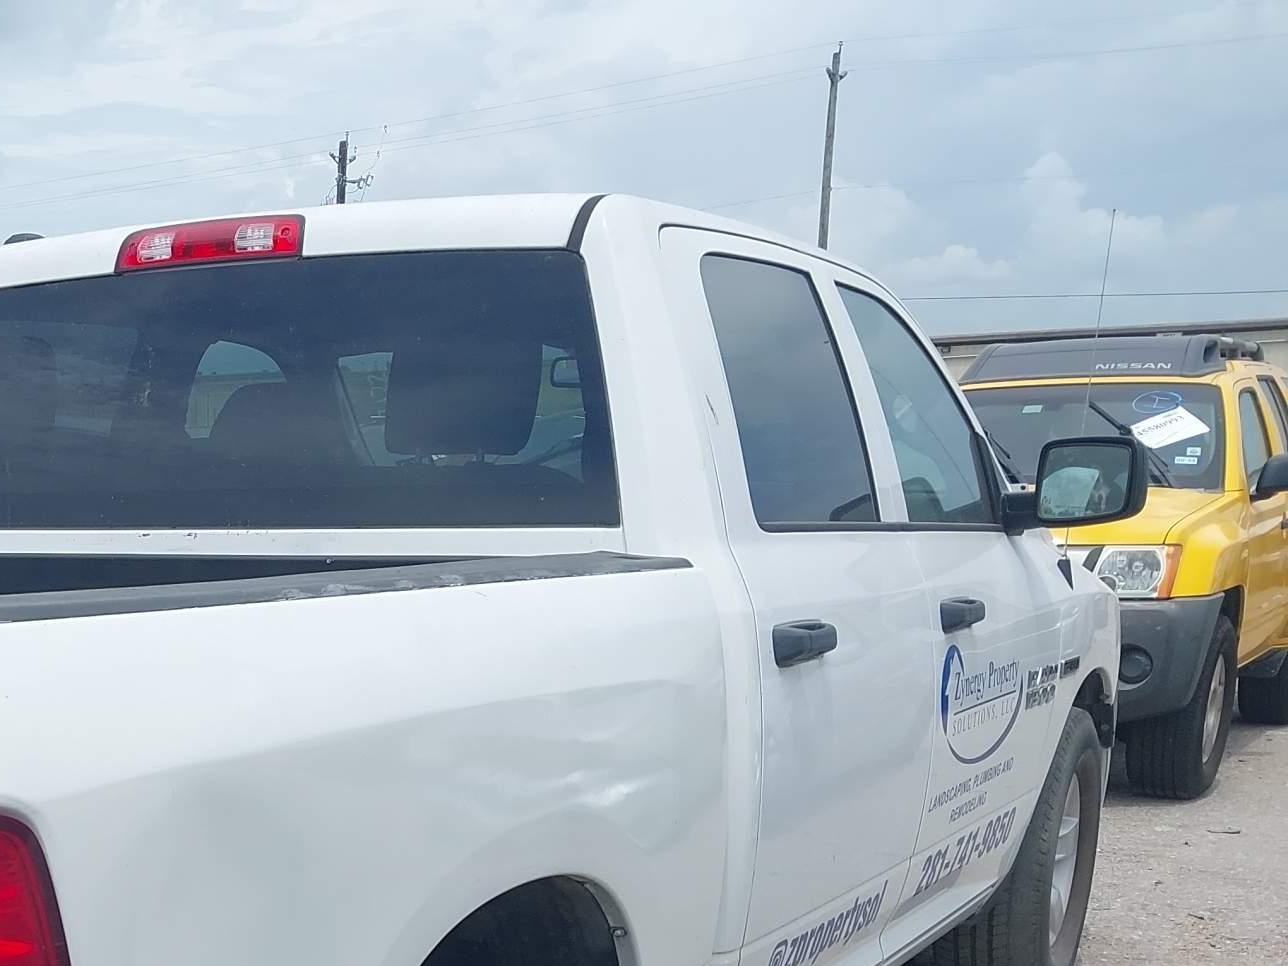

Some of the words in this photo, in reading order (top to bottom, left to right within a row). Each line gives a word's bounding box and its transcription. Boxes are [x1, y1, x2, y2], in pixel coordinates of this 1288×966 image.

[1095, 362, 1172, 370] NISSAN
[954, 671, 987, 706] Zynergy
[988, 659, 1020, 692] Property
[972, 762, 1002, 790] PLUMBING
[1001, 756, 1014, 775] AND
[949, 791, 987, 824] REMODELING
[913, 807, 1016, 897] 281-741-9850
